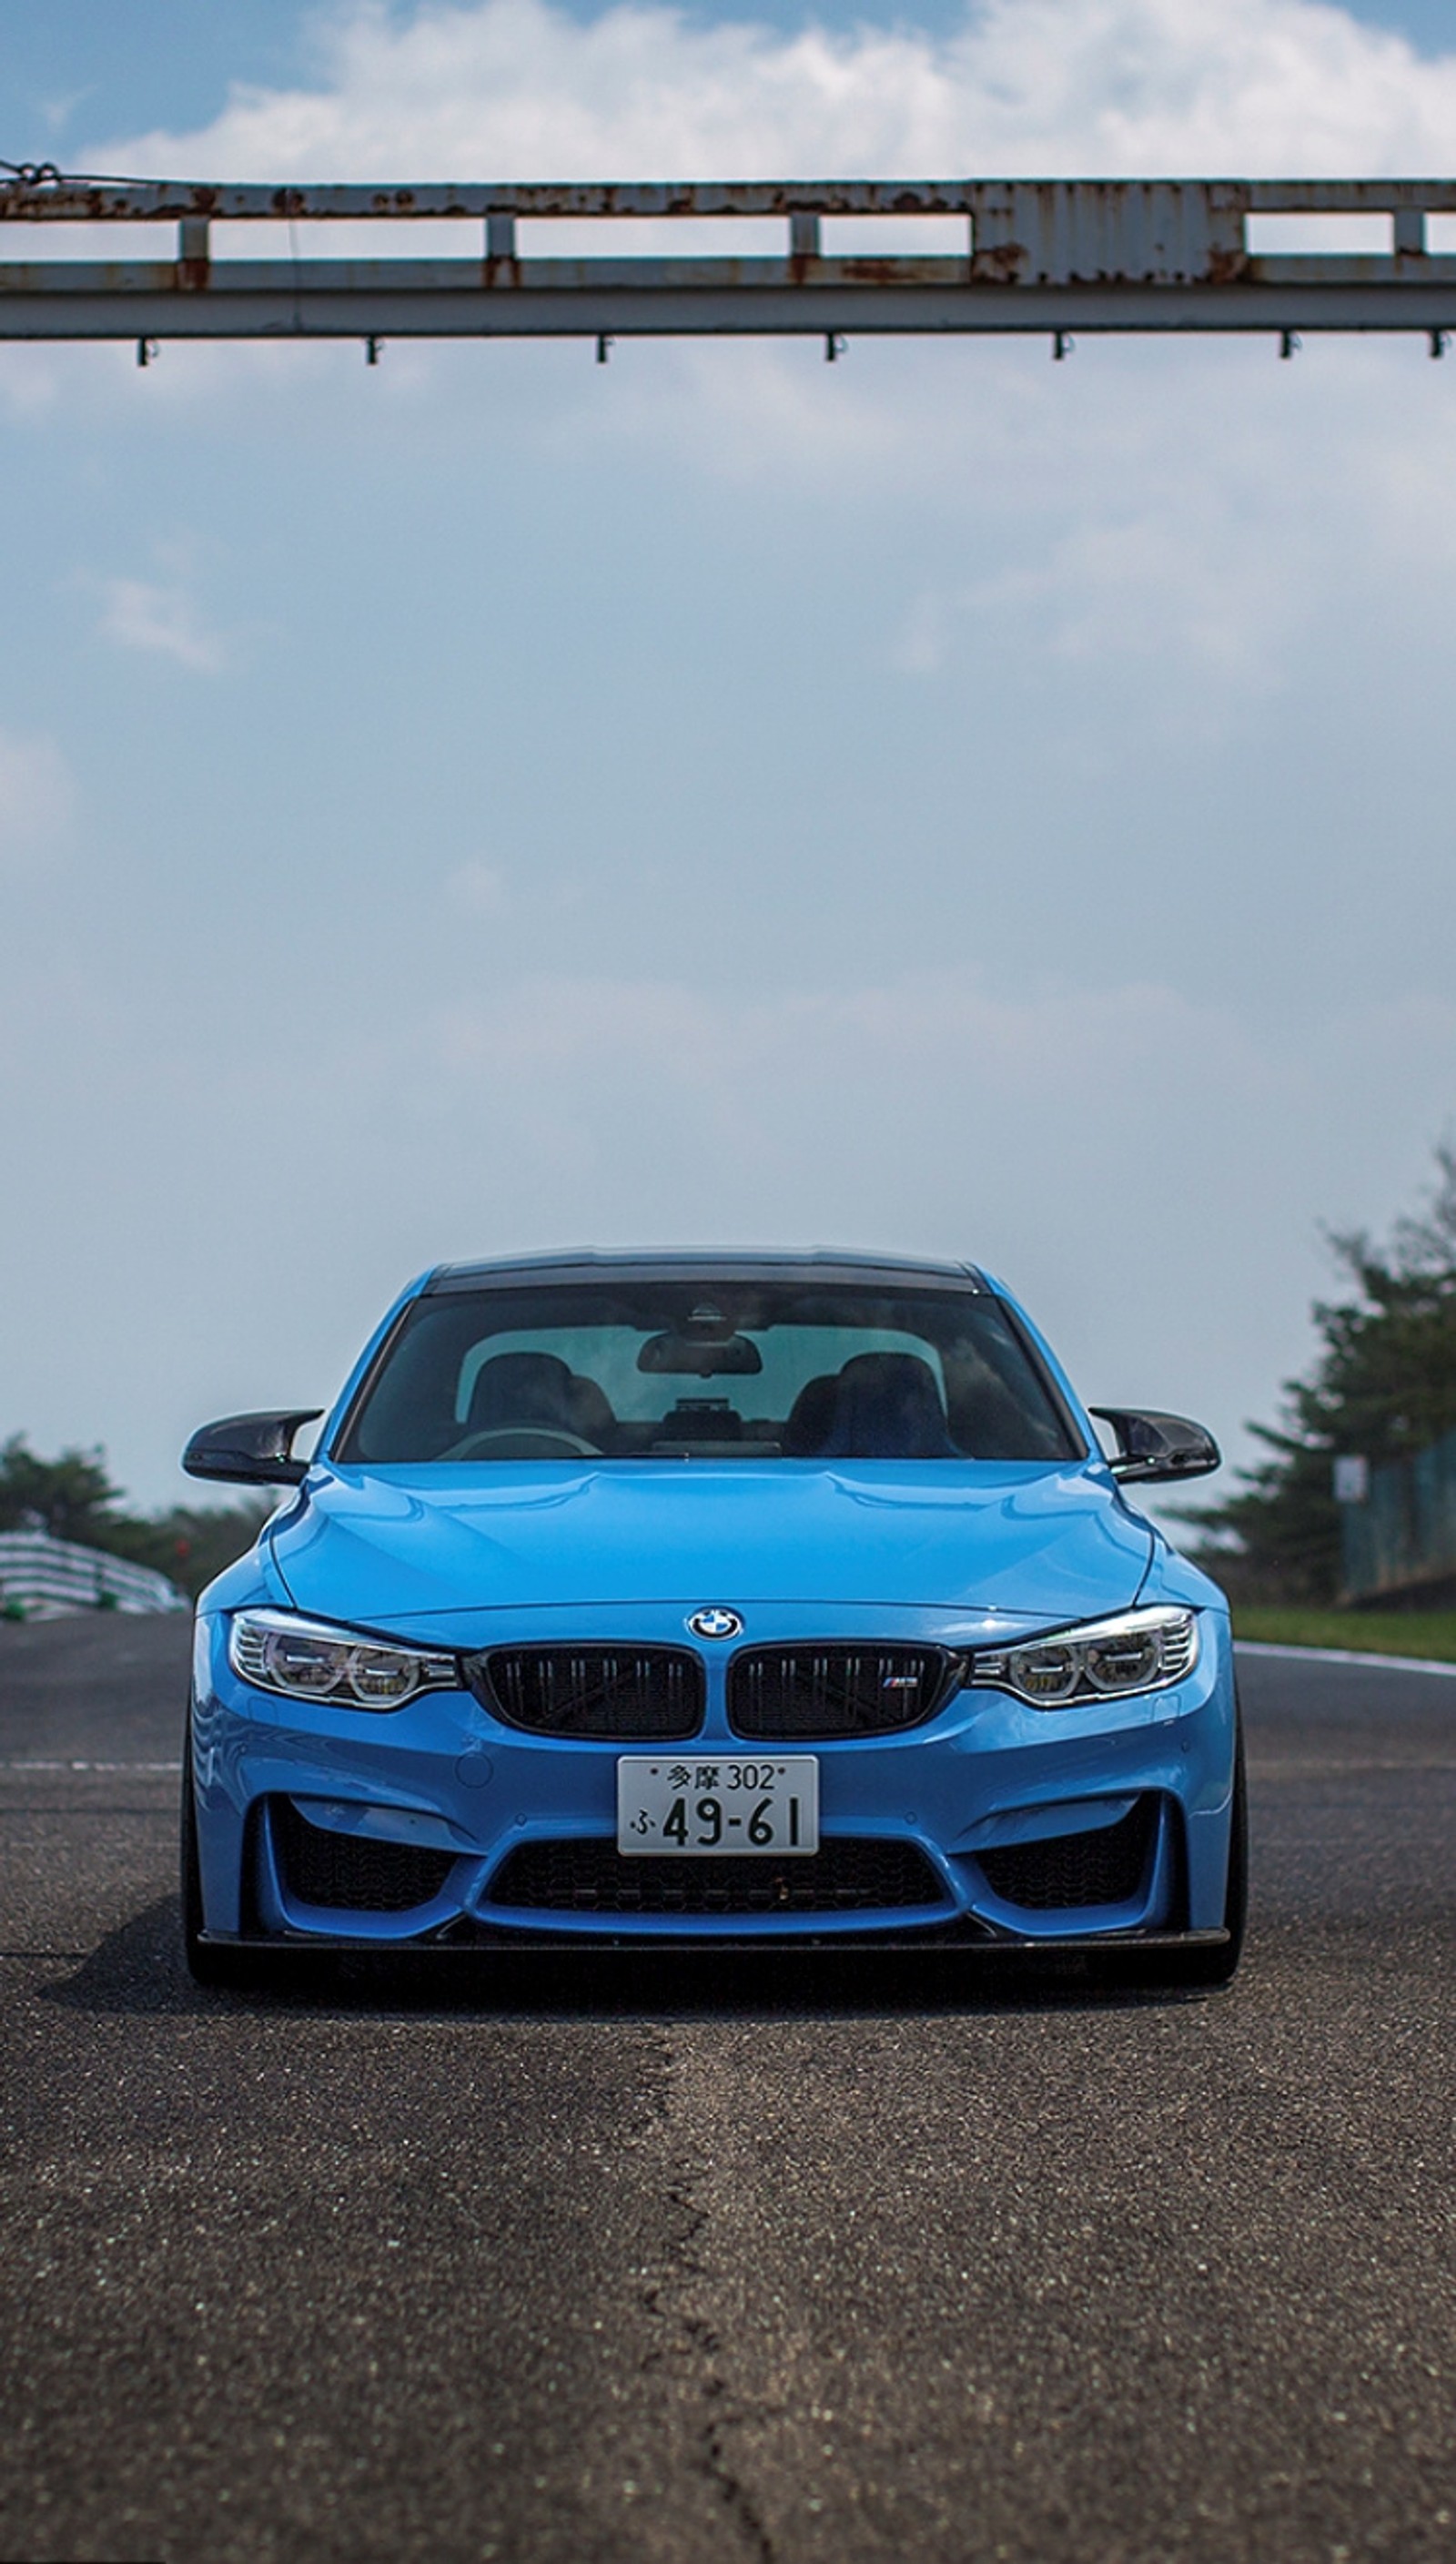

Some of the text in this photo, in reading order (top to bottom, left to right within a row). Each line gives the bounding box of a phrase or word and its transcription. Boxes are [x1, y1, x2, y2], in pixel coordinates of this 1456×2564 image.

[667, 1764, 774, 1790] 多摩 302
[630, 1797, 799, 1848] ふ 49-61
